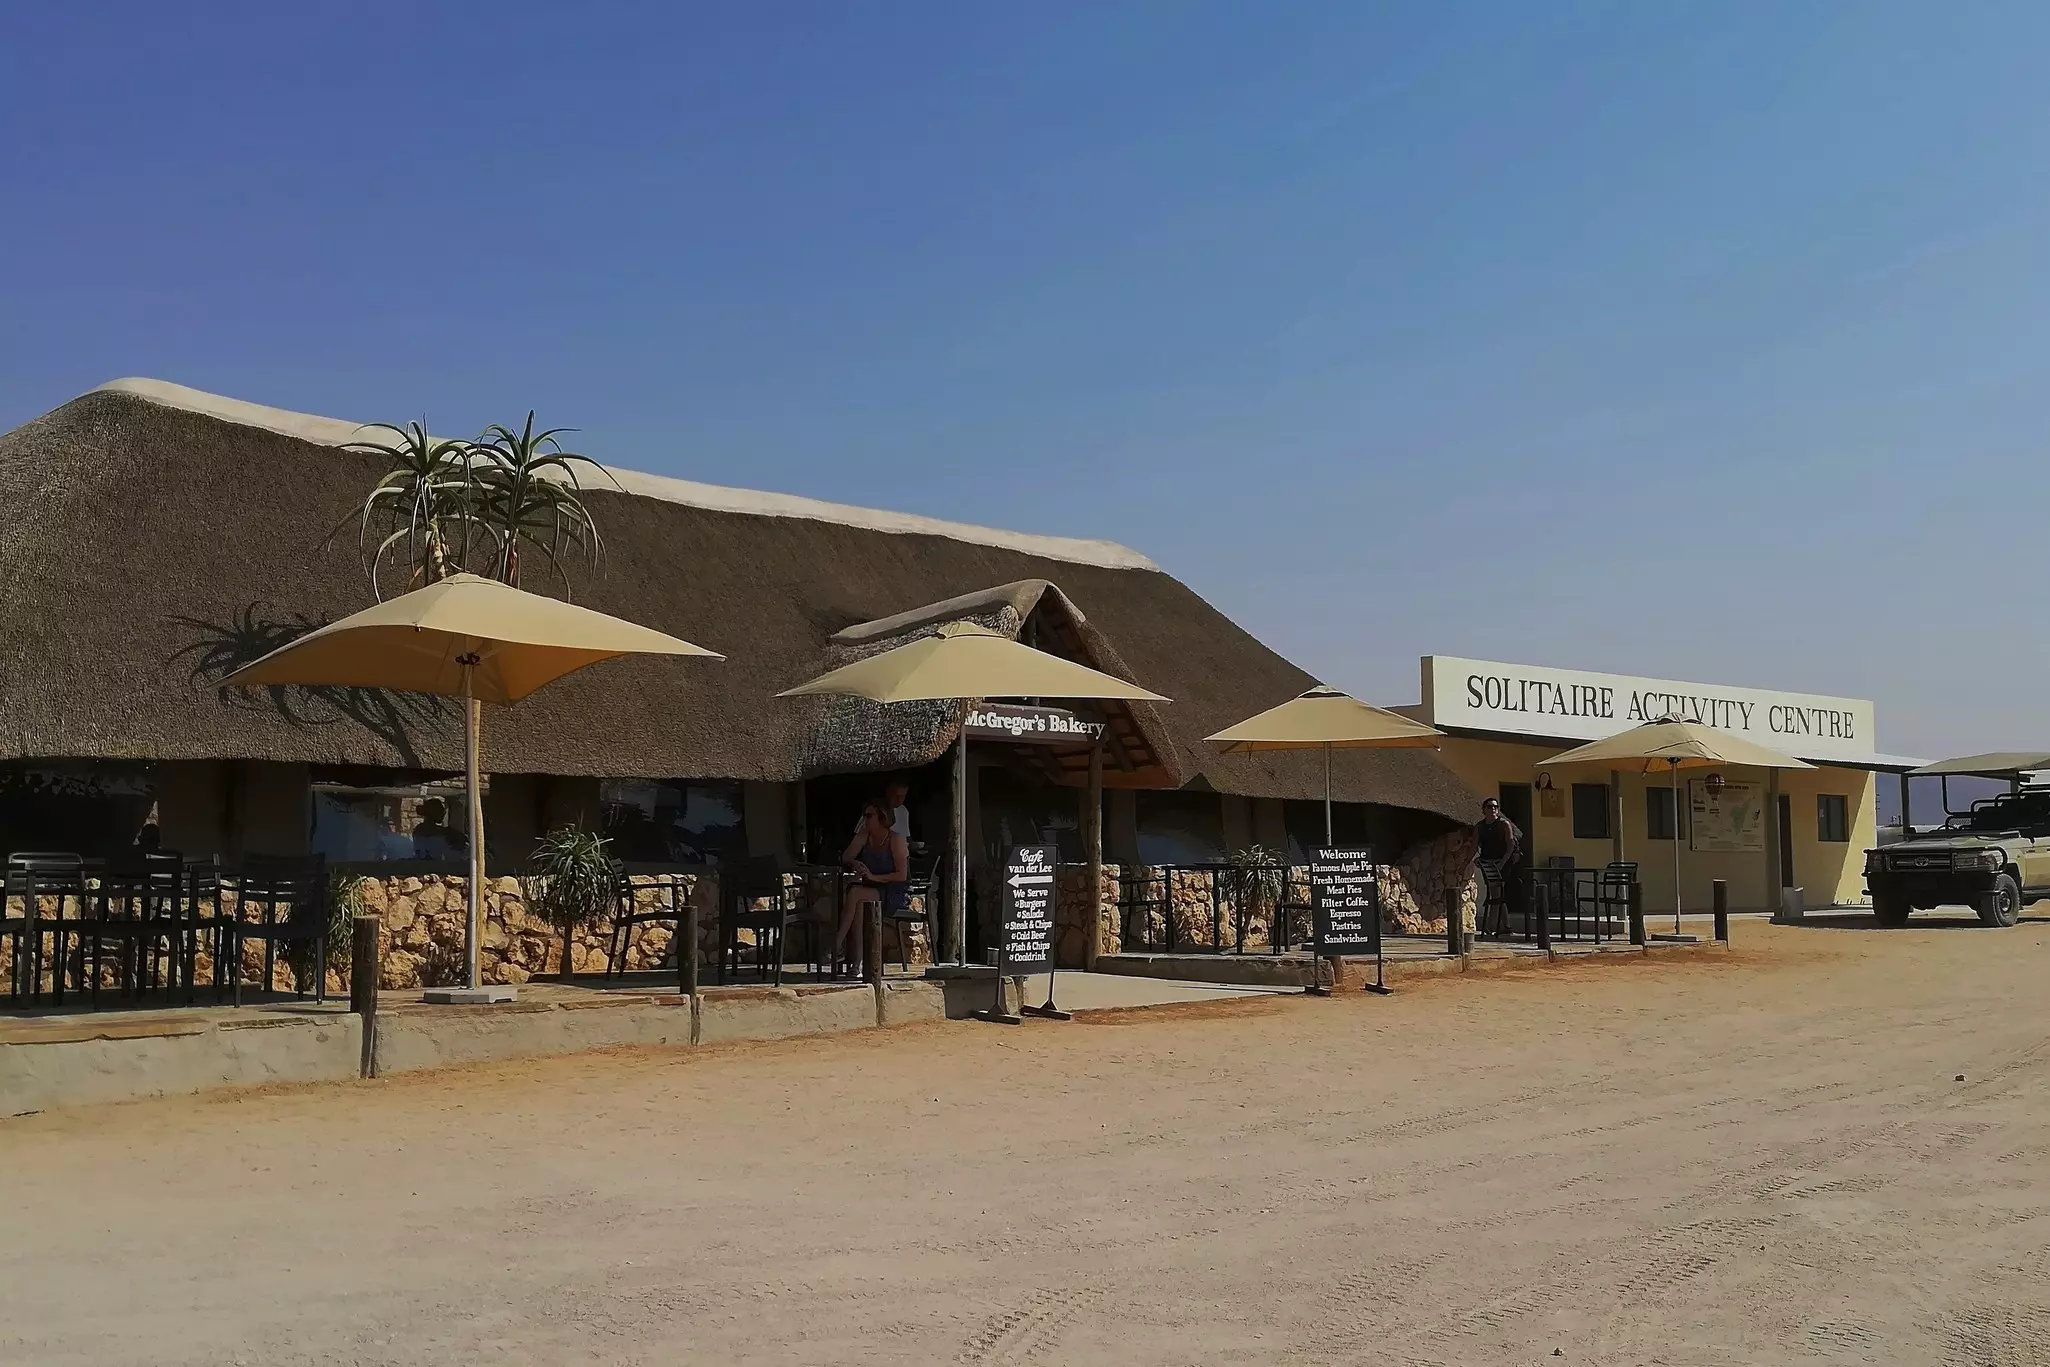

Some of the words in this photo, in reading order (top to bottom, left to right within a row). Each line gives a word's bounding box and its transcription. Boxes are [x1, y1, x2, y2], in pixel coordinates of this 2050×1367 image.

[1467, 674, 1614, 719] SOLITAIRE
[1626, 689, 1755, 730] ACTIVITY
[1769, 704, 1855, 739] CENTRE
[965, 711, 1045, 736] McGregor's
[1049, 715, 1105, 740] Bakery
[1020, 849, 1043, 864] Cafe
[1319, 849, 1367, 859] Welcome
[1008, 865, 1025, 873] van
[1026, 862, 1038, 873] der
[1039, 862, 1053, 873] Lee
[1312, 863, 1340, 873] Famous
[1340, 862, 1360, 873] Apple
[1361, 861, 1373, 871] Pie
[1313, 876, 1333, 885] Fresh
[1334, 873, 1375, 884] Homemade
[1012, 889, 1026, 898] We
[1027, 889, 1049, 897] Serve
[1326, 885, 1345, 895] Meat
[1347, 884, 1362, 894] Pies
[1019, 900, 1047, 910] Burgers
[1321, 898, 1344, 908] Filter
[1345, 897, 1369, 907] Coffee
[1022, 909, 1045, 919] Salads
[1330, 909, 1361, 920] Espresso
[1029, 920, 1034, 929] &
[1035, 919, 1053, 930] Chips
[1331, 921, 1361, 930] Pastries
[1017, 931, 1030, 940] Cold
[1031, 931, 1047, 940] Beer
[1324, 933, 1368, 944] Sandwiches
[1011, 942, 1026, 951] Fish
[1027, 942, 1031, 950] &
[1032, 942, 1050, 952] Chips
